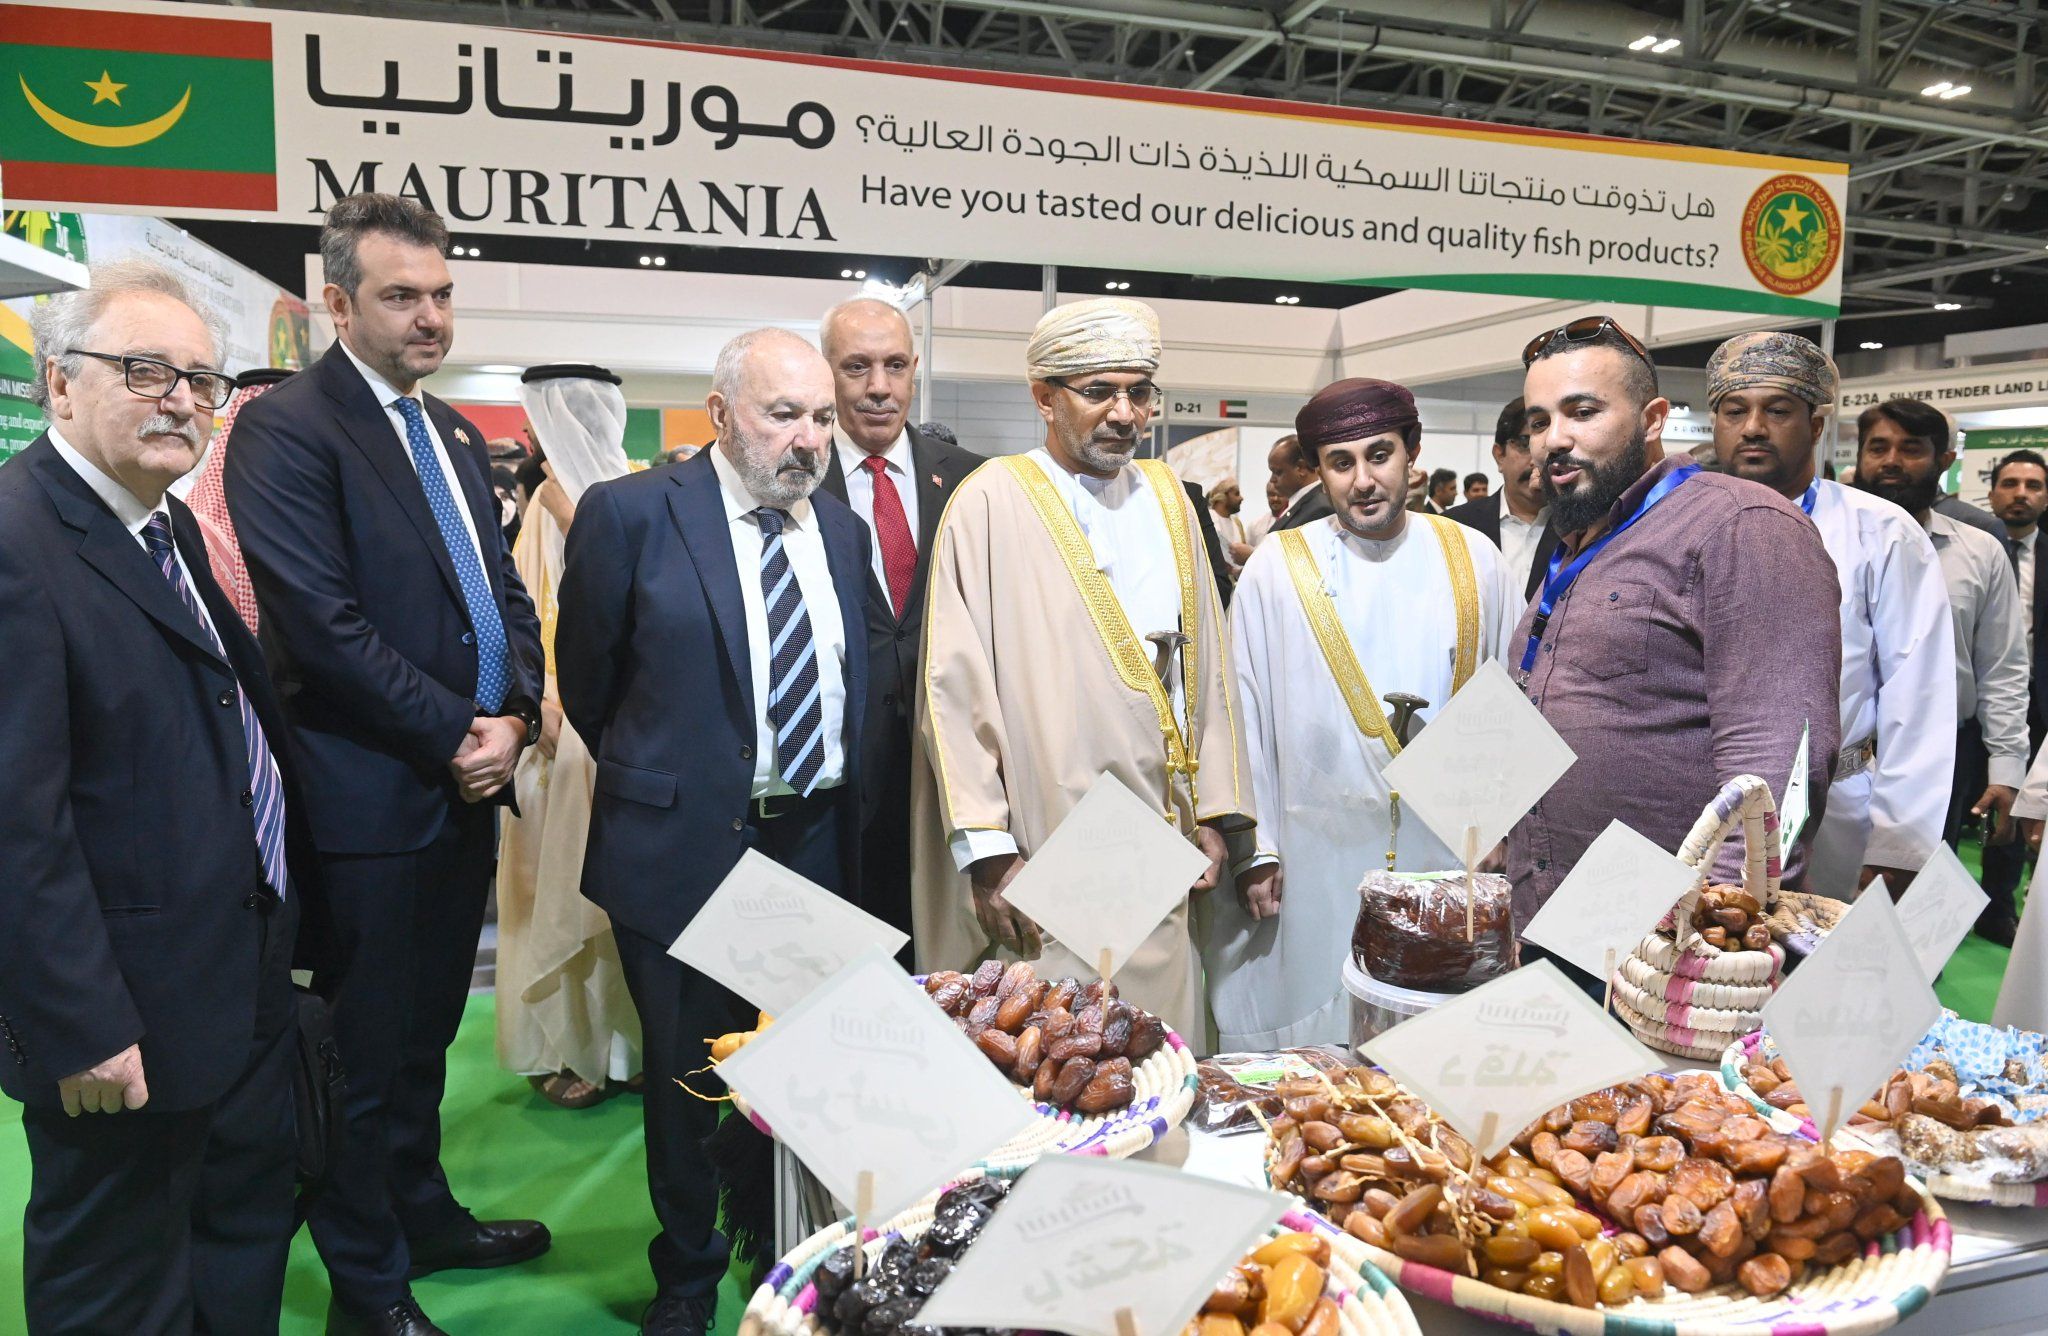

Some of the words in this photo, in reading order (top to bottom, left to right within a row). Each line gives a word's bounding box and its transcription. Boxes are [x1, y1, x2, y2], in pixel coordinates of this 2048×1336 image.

[306, 33, 836, 151] موريتانيا
[856, 113, 992, 154] العالية؟
[1003, 126, 1120, 166] الجودة
[1130, 136, 1190, 169] ذات
[1200, 144, 1308, 180] اللذيذة
[1315, 153, 1449, 193] السمكية
[306, 157, 838, 242] MAURITANIA
[1459, 167, 1566, 206] منتجاتنا
[1573, 184, 1666, 216] تذوقت
[863, 174, 952, 209] Have
[961, 189, 1026, 219] you
[1036, 189, 1141, 222] tasted
[1152, 203, 1207, 227] our
[1214, 200, 1354, 240] delicious
[1362, 216, 1419, 244] and
[1427, 222, 1527, 259] quality
[1533, 226, 1581, 257] fish
[1589, 236, 1719, 269] products?
[1672, 192, 1715, 221] هل
[1174, 402, 1202, 413] D-21
[1842, 393, 1879, 407] E-23A
[1937, 384, 1990, 399] TENDER
[1995, 381, 2032, 395] LAND
